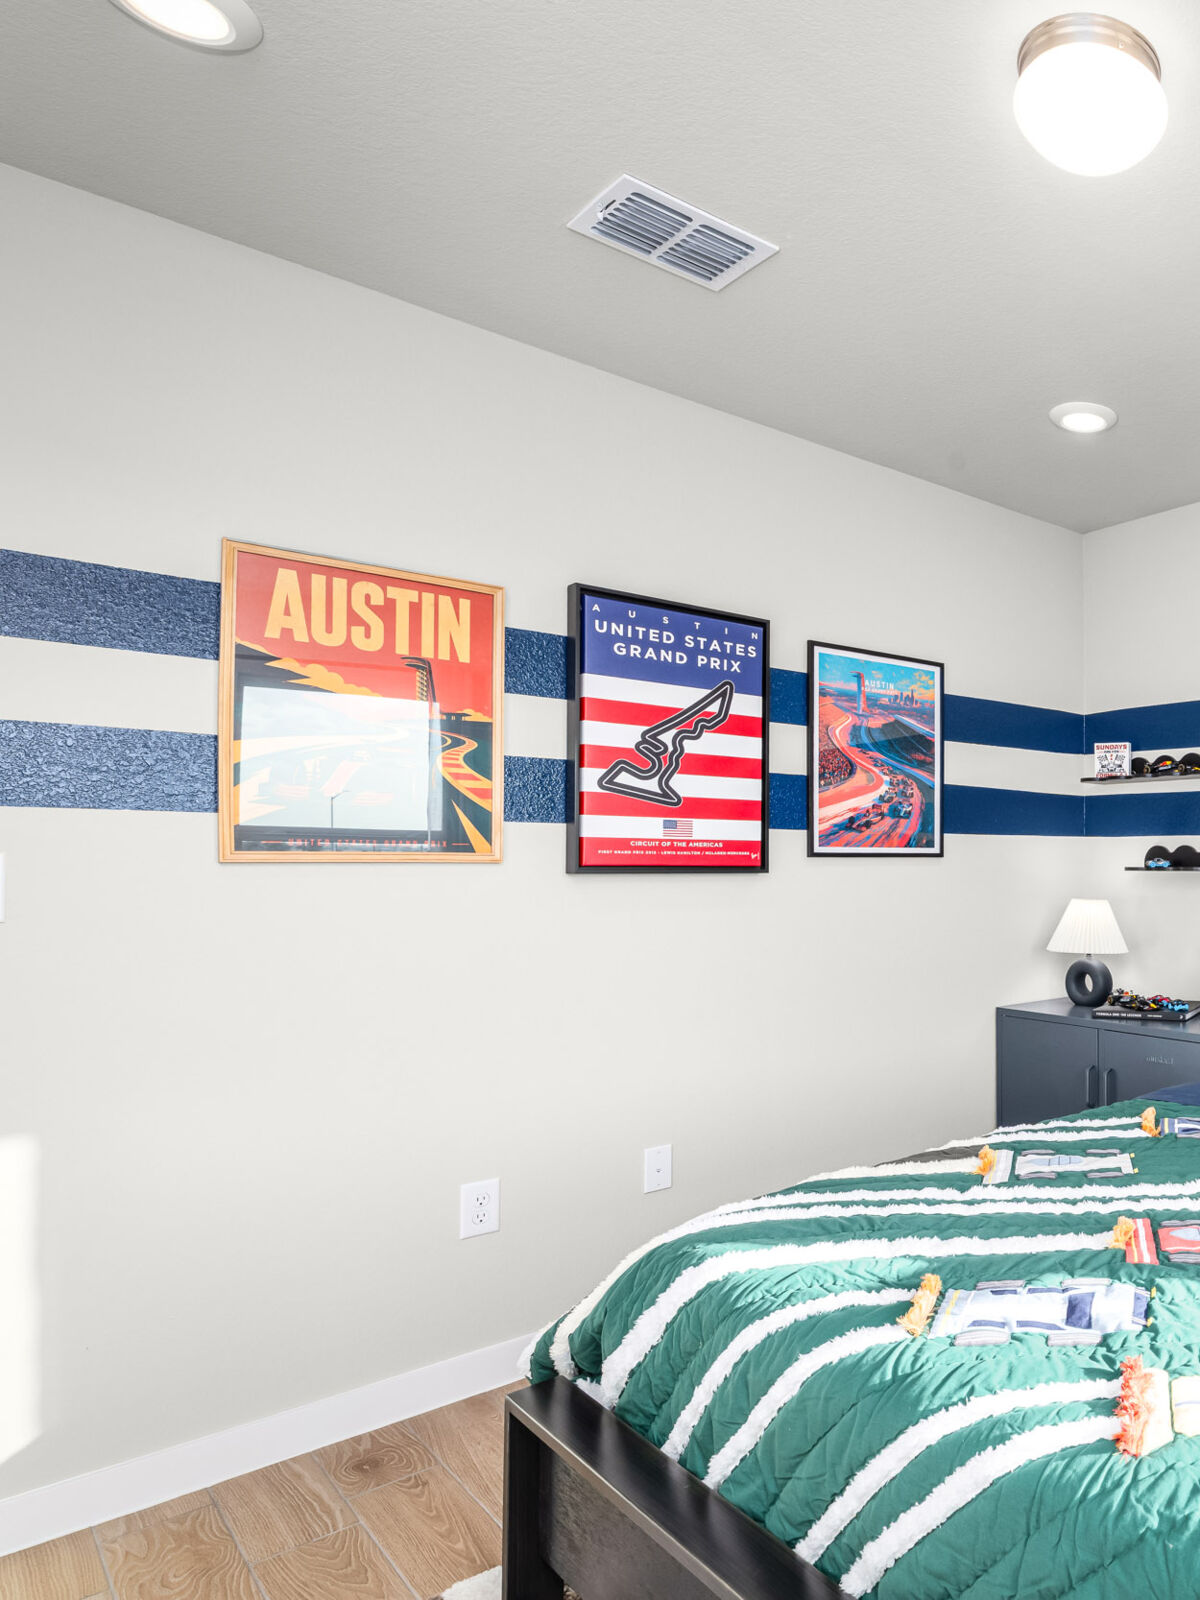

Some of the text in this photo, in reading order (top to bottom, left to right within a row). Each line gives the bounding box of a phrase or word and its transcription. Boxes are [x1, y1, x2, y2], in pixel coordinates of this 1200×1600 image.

[264, 567, 471, 664] AUSTIN
[592, 603, 758, 640] AUSTIN
[594, 619, 757, 658] UNITED STATES
[613, 642, 741, 673] GRAND PRIX
[864, 679, 895, 690] AUSTIN
[1095, 743, 1128, 751] SUNDAYS
[287, 838, 448, 848] UNITED STATES GRAND PRIX
